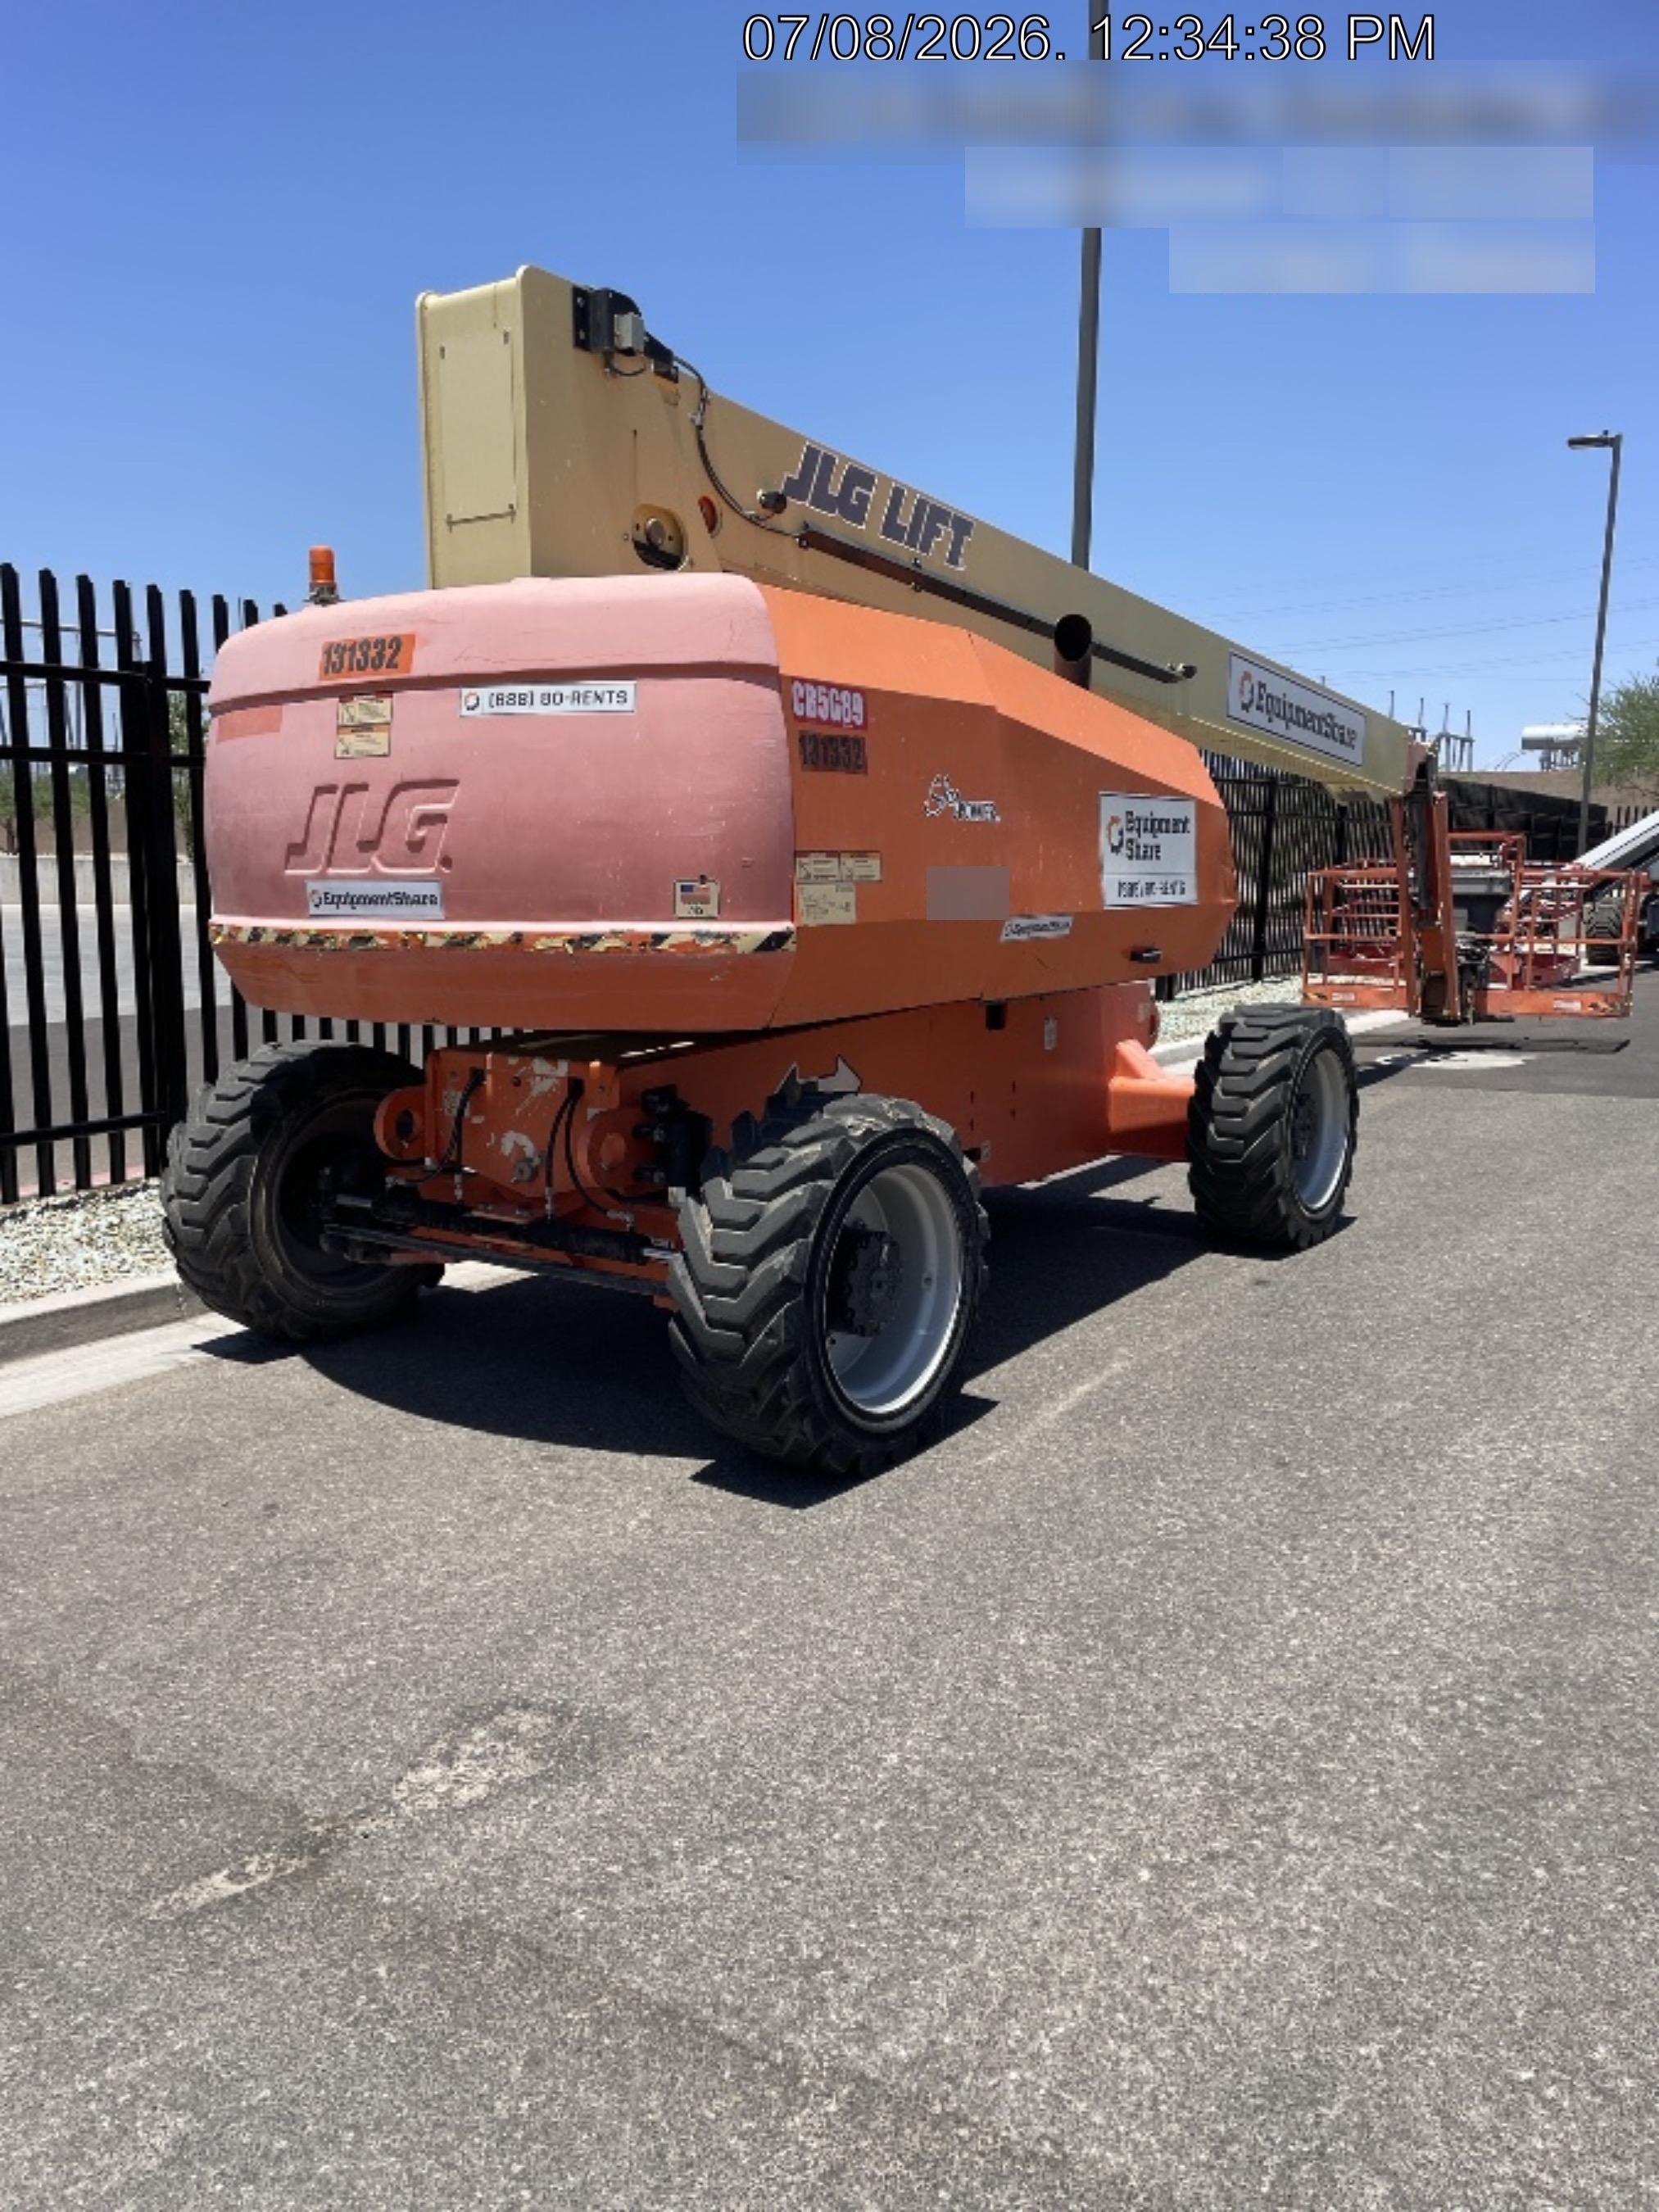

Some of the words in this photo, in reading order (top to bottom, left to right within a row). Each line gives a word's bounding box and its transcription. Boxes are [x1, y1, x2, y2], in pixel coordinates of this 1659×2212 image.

[779, 440, 879, 530] JLG
[879, 480, 977, 571] LIFT
[324, 636, 402, 675] 131332
[1255, 681, 1358, 750] EquipmentShare
[284, 778, 460, 875] JLG
[1125, 810, 1190, 839] Equipment
[1125, 837, 1162, 861] Share
[323, 891, 438, 910] EquipmentShare
